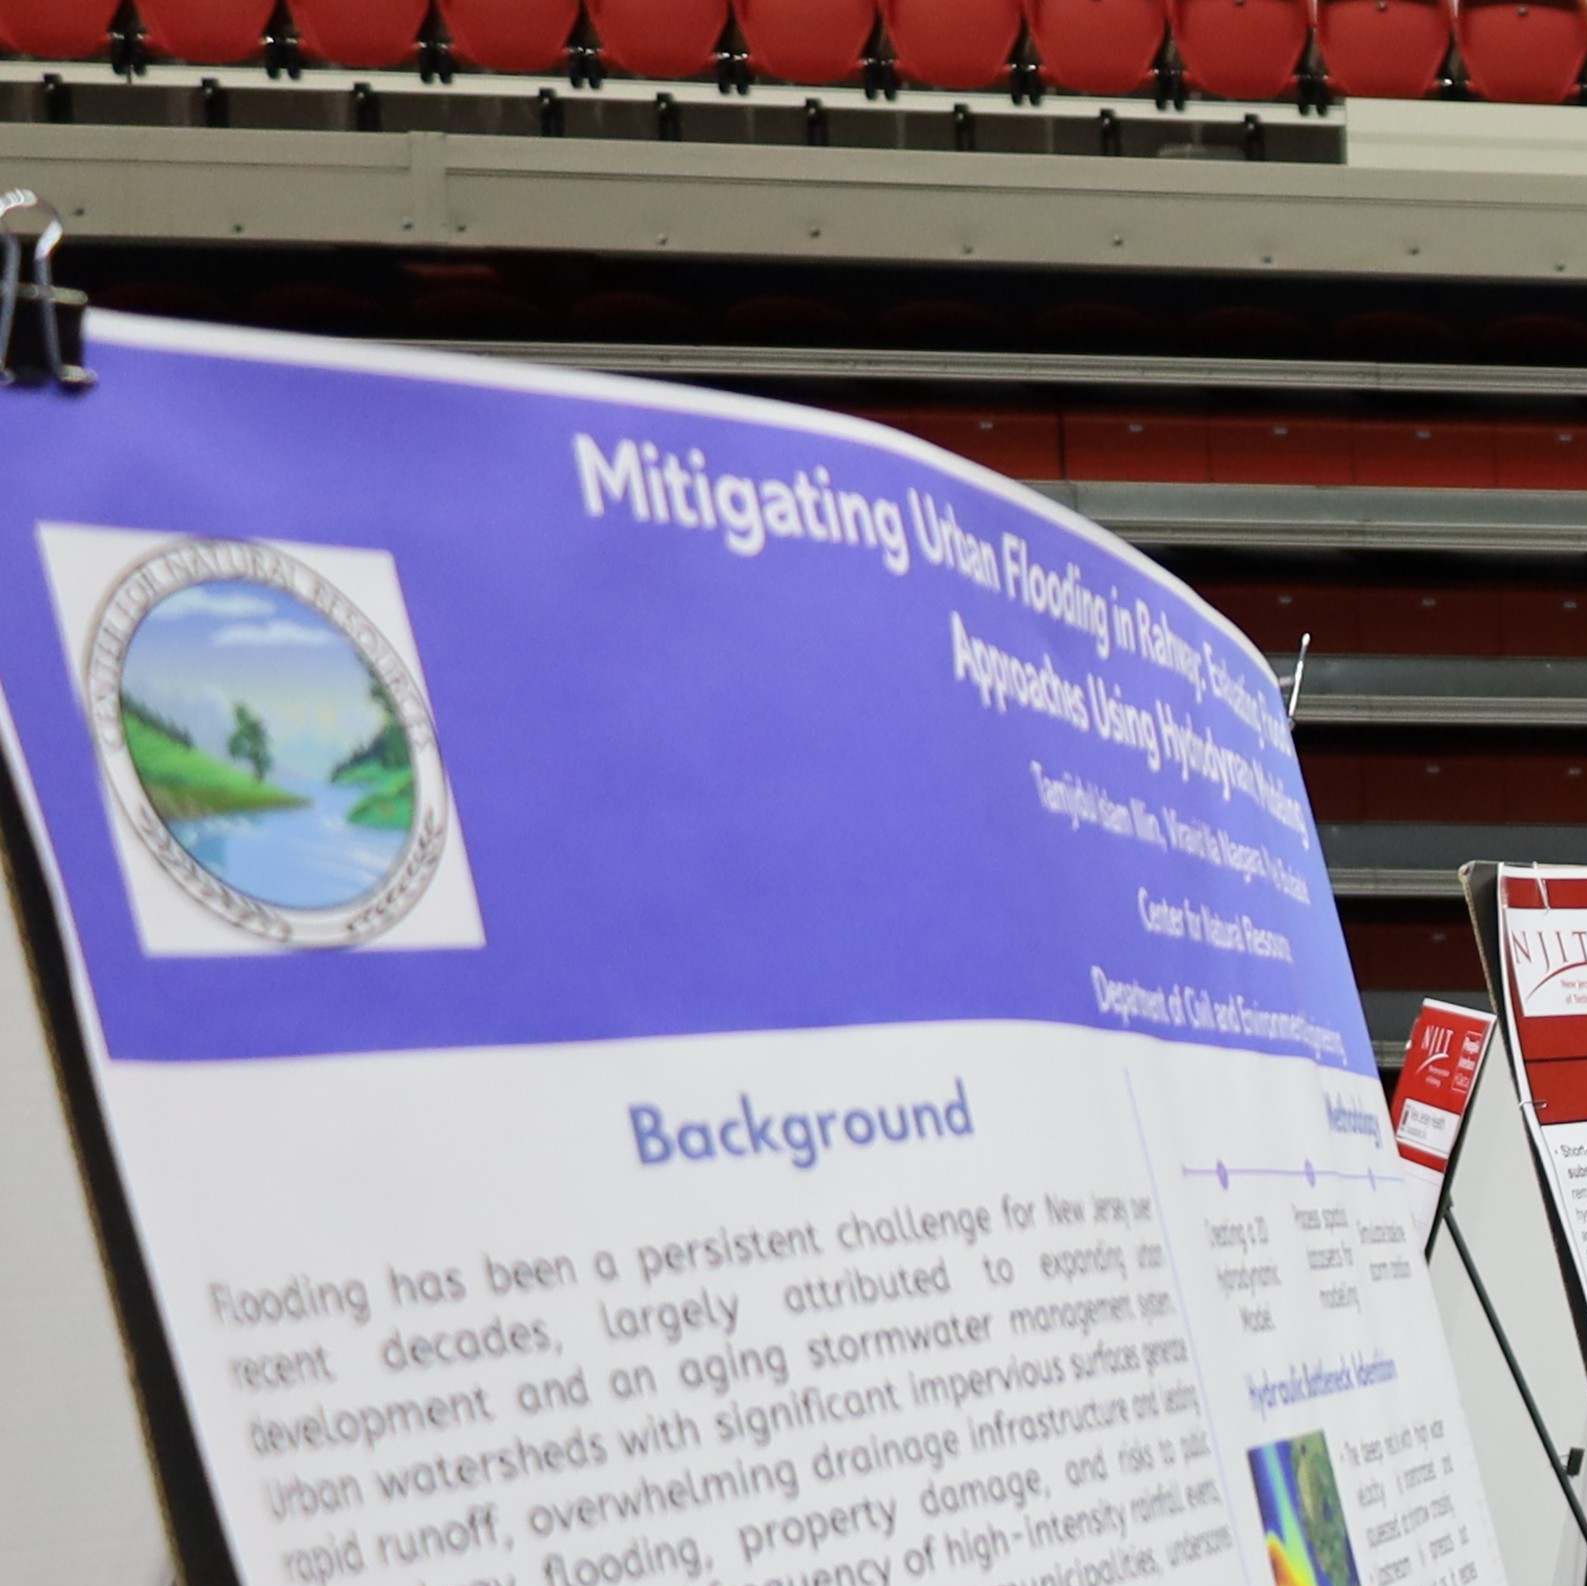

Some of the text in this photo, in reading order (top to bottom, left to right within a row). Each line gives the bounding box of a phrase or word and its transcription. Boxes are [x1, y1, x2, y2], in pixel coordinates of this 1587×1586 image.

[574, 430, 911, 576] Mitigating
[906, 486, 1001, 592] Urban
[1001, 531, 1110, 660] Flooding
[1087, 674, 1162, 773] Using
[628, 1076, 975, 1169] Background
[209, 1274, 370, 1326] Flooding
[388, 1263, 466, 1307] has
[484, 1252, 576, 1297] been
[595, 1249, 618, 1282] a
[637, 1221, 822, 1286] persistent
[837, 1200, 990, 1248] challenge
[1002, 1193, 1036, 1229] for
[1045, 1192, 1084, 1226] New
[230, 1242, 1128, 1392] recent decades, largely attributed to expanding
[248, 1291, 1132, 1457] development and an aging stormwater management
[378, 1435, 607, 1501] watersheds
[622, 1414, 701, 1461] with
[715, 1381, 902, 1447] significant
[910, 1352, 1065, 1407] impervious
[1072, 1340, 1141, 1380] surfaces
[378, 1505, 513, 1566] runoff,
[529, 1457, 799, 1537] overwhelming
[812, 1427, 960, 1481] drainage
[968, 1396, 1129, 1451] infrastructure
[739, 1498, 897, 1562] property
[920, 1467, 1052, 1518] damage,
[1065, 1449, 1108, 1487] and
[1118, 1440, 1154, 1474] risks
[905, 1537, 937, 1576] of
[947, 1502, 1127, 1572] high-intensity
